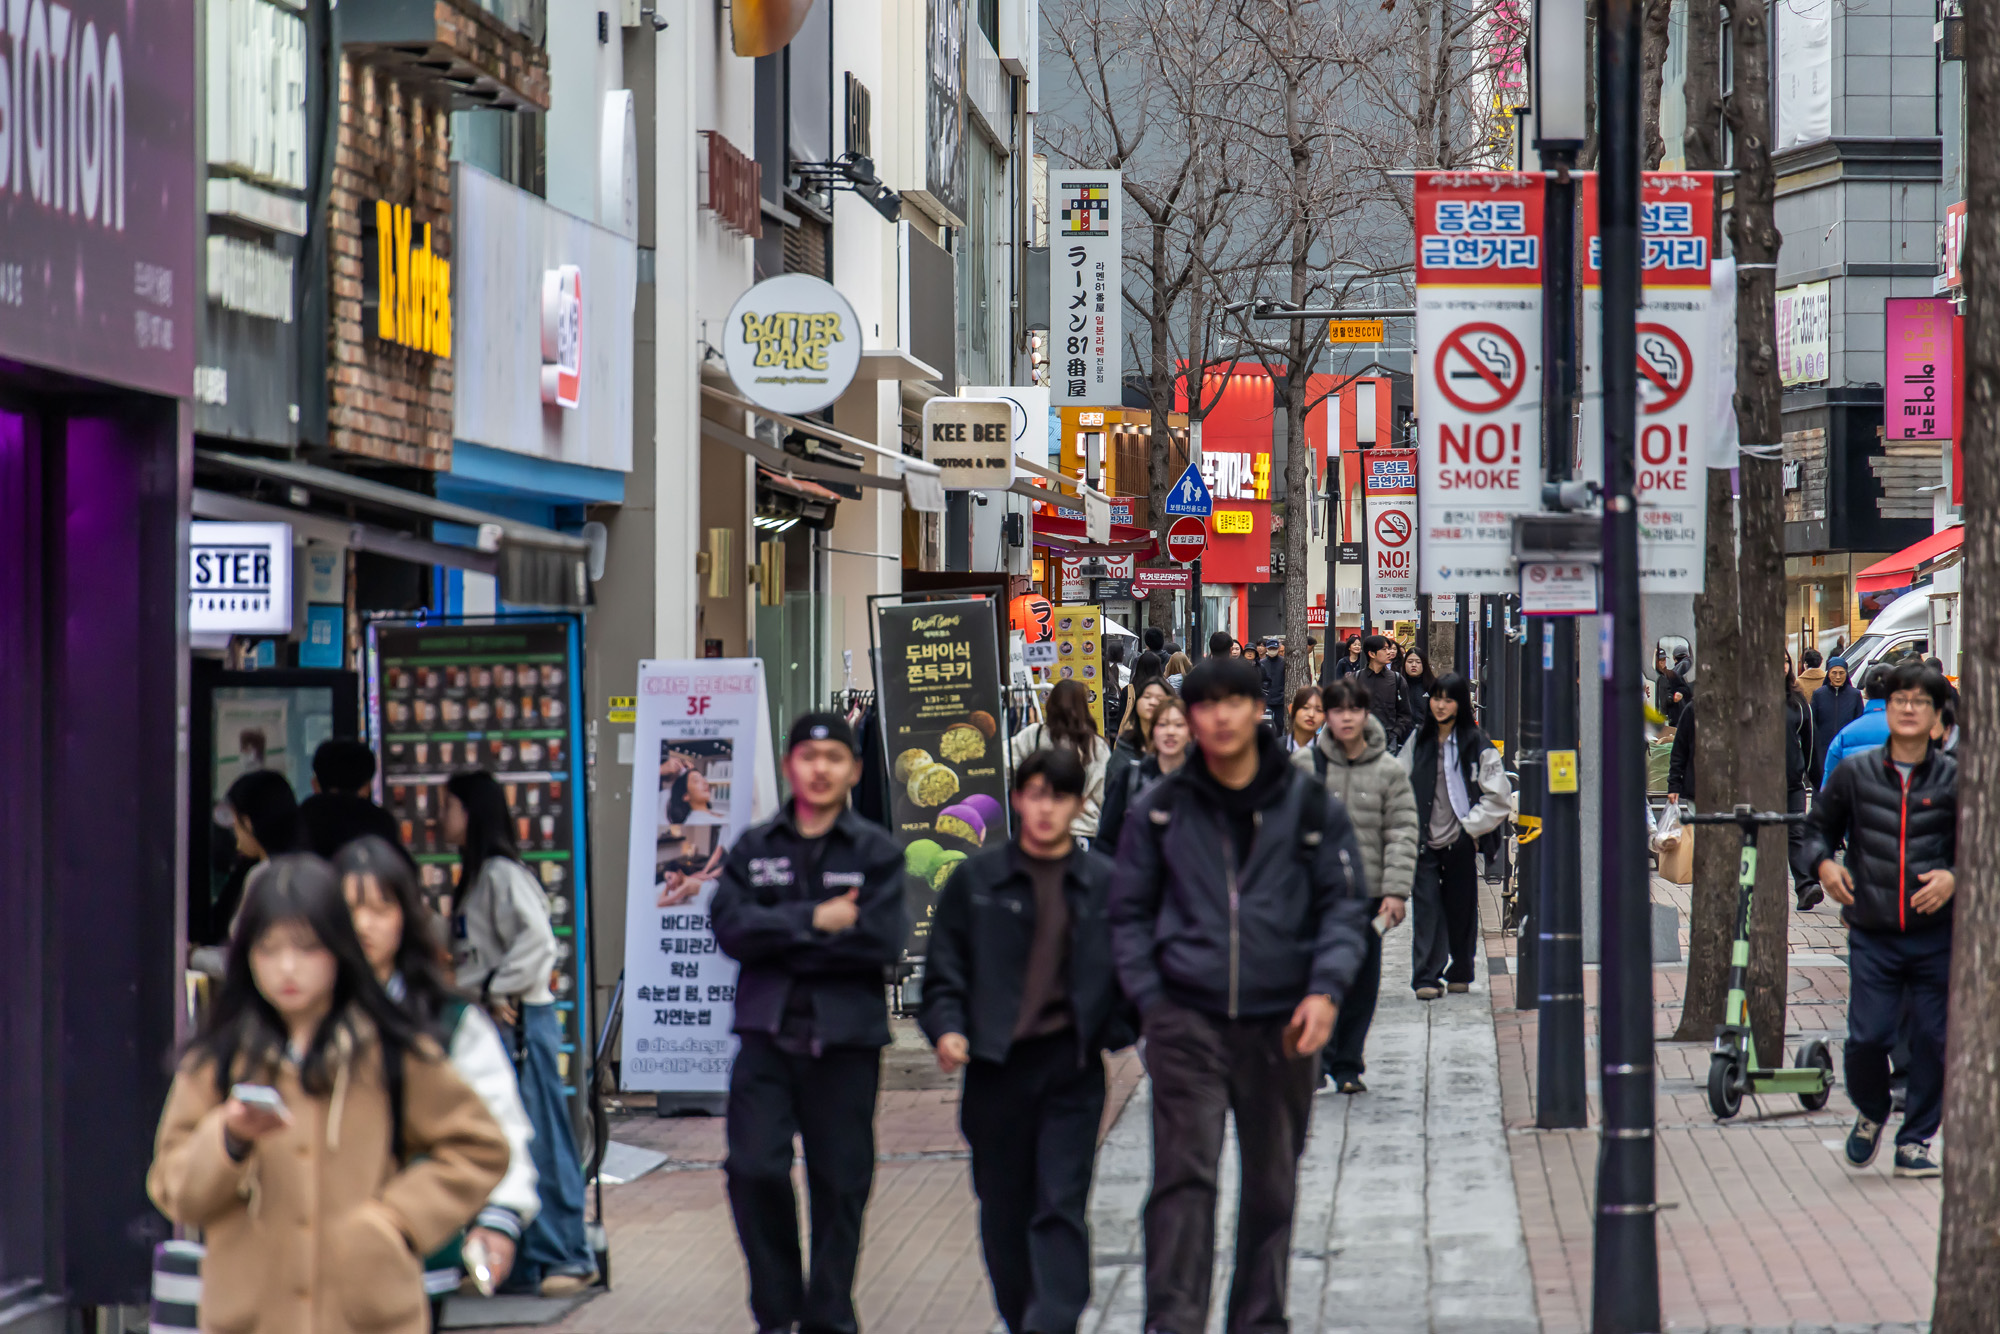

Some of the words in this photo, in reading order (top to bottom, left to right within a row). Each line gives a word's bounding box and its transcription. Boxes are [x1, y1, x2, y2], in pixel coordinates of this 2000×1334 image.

[1437, 202, 1523, 233] 동성로
[1641, 203, 1691, 233] 성로
[1423, 237, 1537, 267] 금연거리
[742, 311, 844, 344] BUTTER
[1067, 245, 1089, 398] ラーメン81番屋
[1333, 326, 1381, 338] 생활안전CCTV
[1095, 315, 1105, 356] 일본라멘
[754, 335, 829, 370] BAKE
[933, 423, 967, 442] KEE
[973, 423, 1007, 442] BEE
[1438, 423, 1521, 464] NO!
[1641, 424, 1688, 465] O!
[986, 458, 1006, 468] PUB
[1373, 461, 1409, 474] 동성로
[1368, 475, 1415, 488] 금연거리
[1438, 469, 1520, 489] SMOKE
[1639, 470, 1687, 490] OKE
[196, 553, 270, 584] STER
[1377, 551, 1410, 568] NO!
[1378, 570, 1409, 578] SMOKE
[1031, 601, 1053, 642] ラーメ
[905, 641, 971, 663] 두바이식
[907, 661, 972, 684] 쫀득쿠키
[686, 695, 711, 716] 3F
[637, 985, 681, 1001] 속눈썹
[654, 1008, 712, 1026] 자연눈썹
